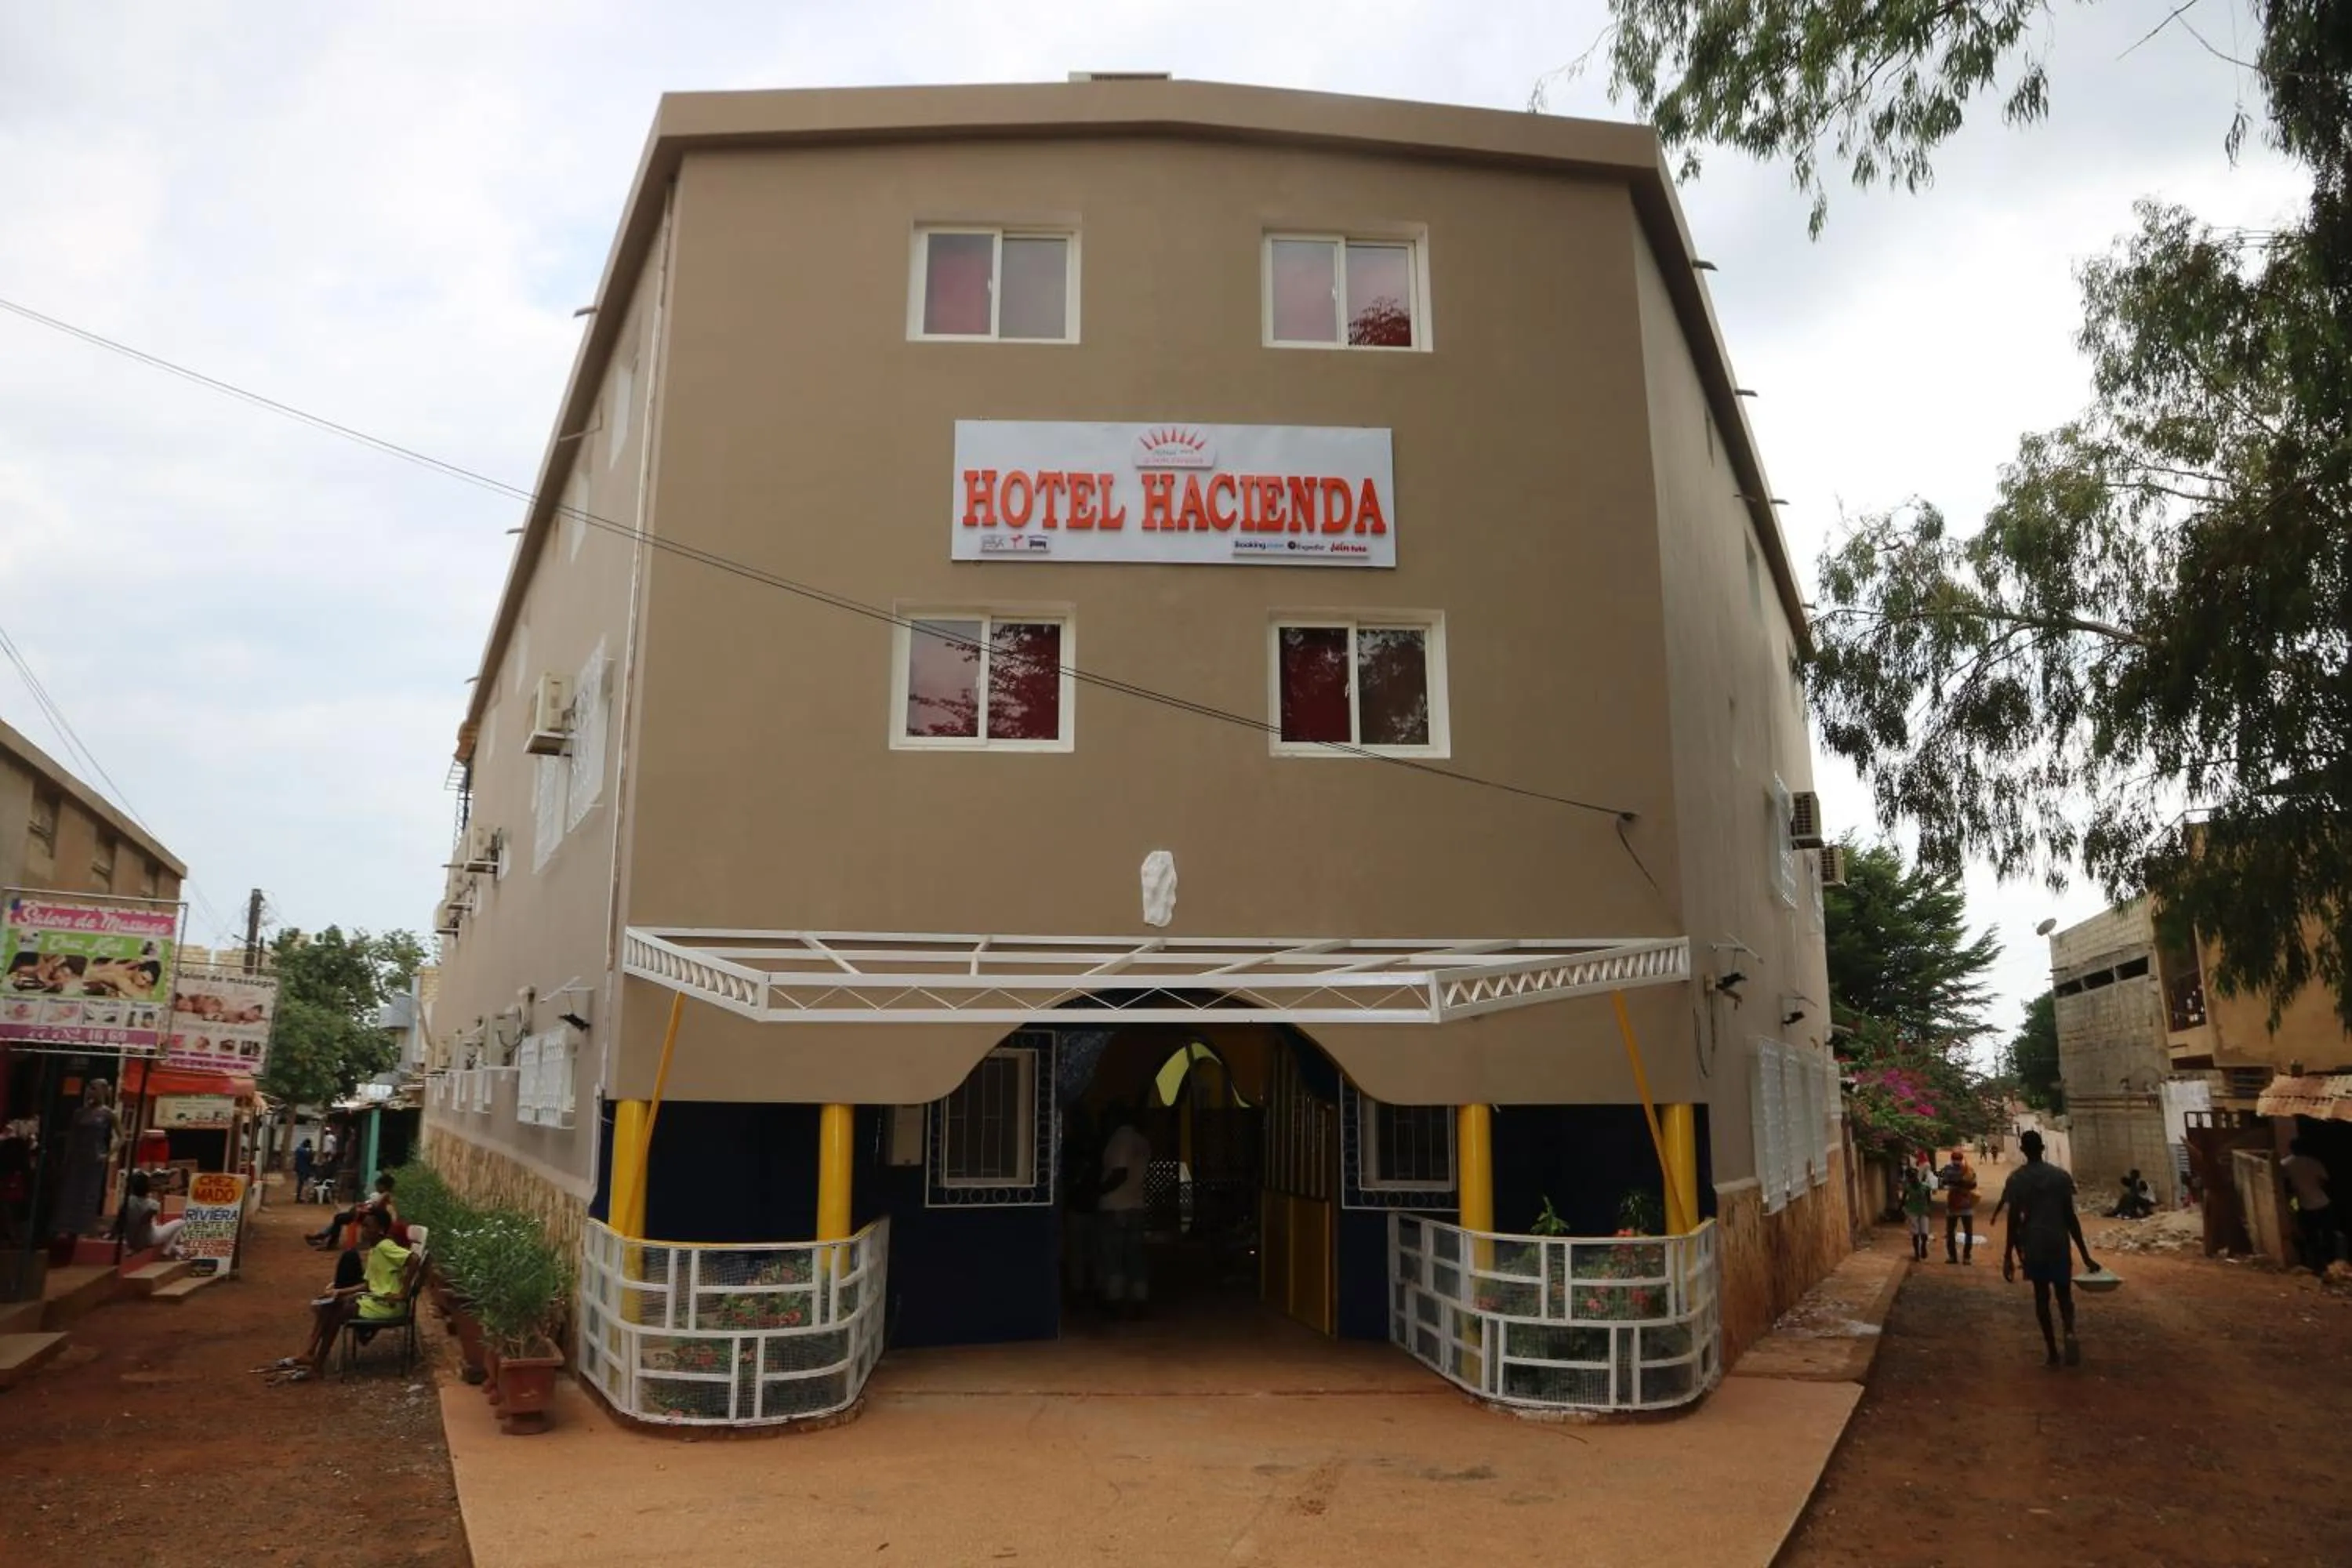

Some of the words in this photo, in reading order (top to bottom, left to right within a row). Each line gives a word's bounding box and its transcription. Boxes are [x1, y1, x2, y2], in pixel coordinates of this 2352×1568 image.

[963, 470, 1127, 530] HOTEL
[1141, 473, 1387, 534] HACIENDA
[75, 911, 97, 929] de
